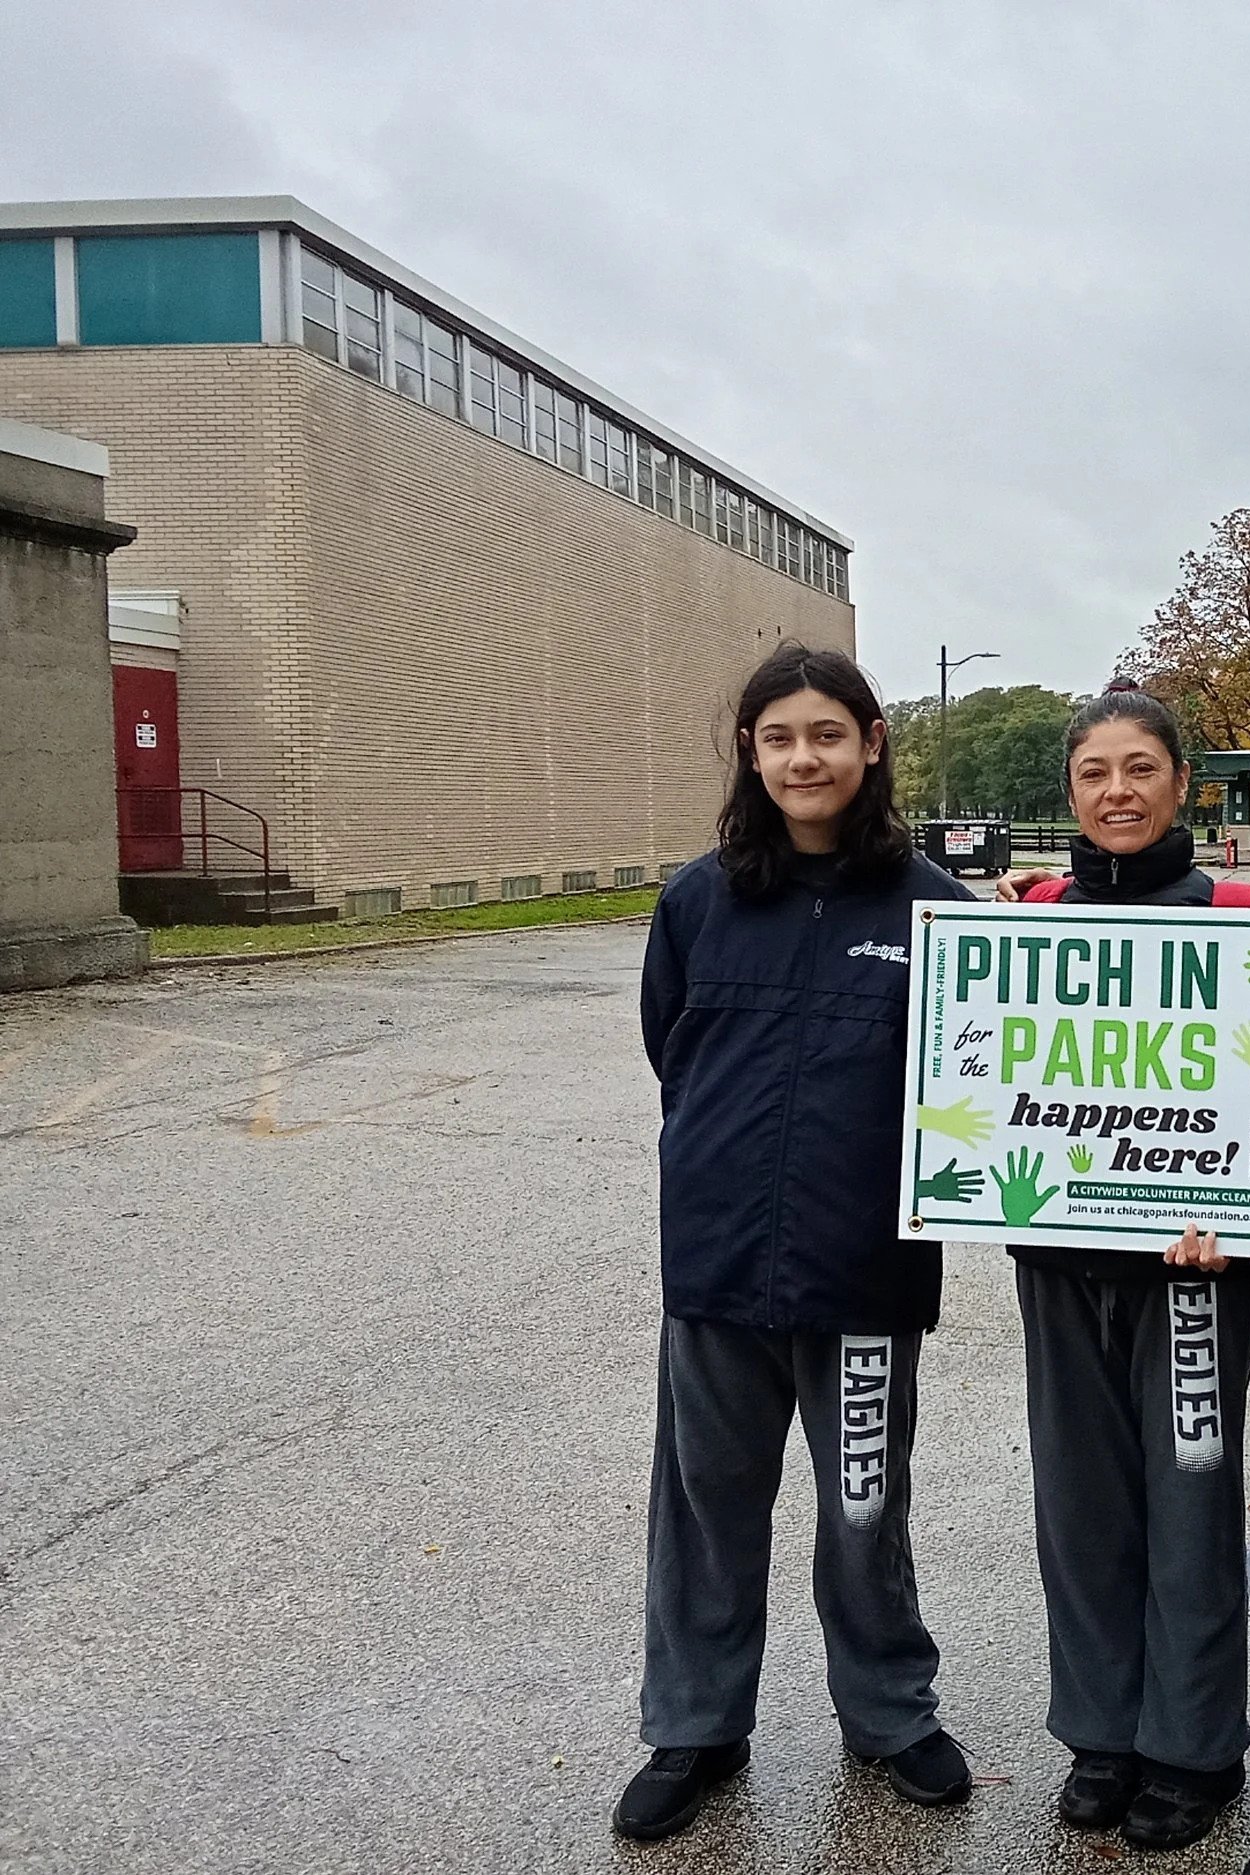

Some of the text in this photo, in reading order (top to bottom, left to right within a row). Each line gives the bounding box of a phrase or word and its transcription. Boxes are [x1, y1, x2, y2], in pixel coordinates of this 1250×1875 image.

[956, 935, 1219, 1010] PITCH IN
[932, 937, 947, 1078] FREE, FUN & FAMILY-FRIENDLY!
[954, 1020, 993, 1051] for
[1001, 1017, 1216, 1092] PARKS
[959, 1053, 989, 1077] the
[1007, 1092, 1219, 1138] happens
[1109, 1137, 1240, 1176] here!
[1067, 1203, 1088, 1215] Join
[1090, 1206, 1102, 1214] us
[1104, 1206, 1115, 1215] at
[1070, 1185, 1079, 1195] A
[1080, 1185, 1129, 1197] CITYWIDE
[1130, 1187, 1191, 1200] VOLUNTEER
[1192, 1190, 1220, 1201] PARK
[1172, 1282, 1219, 1442] EAGLES
[844, 1344, 887, 1501] EAGLES
